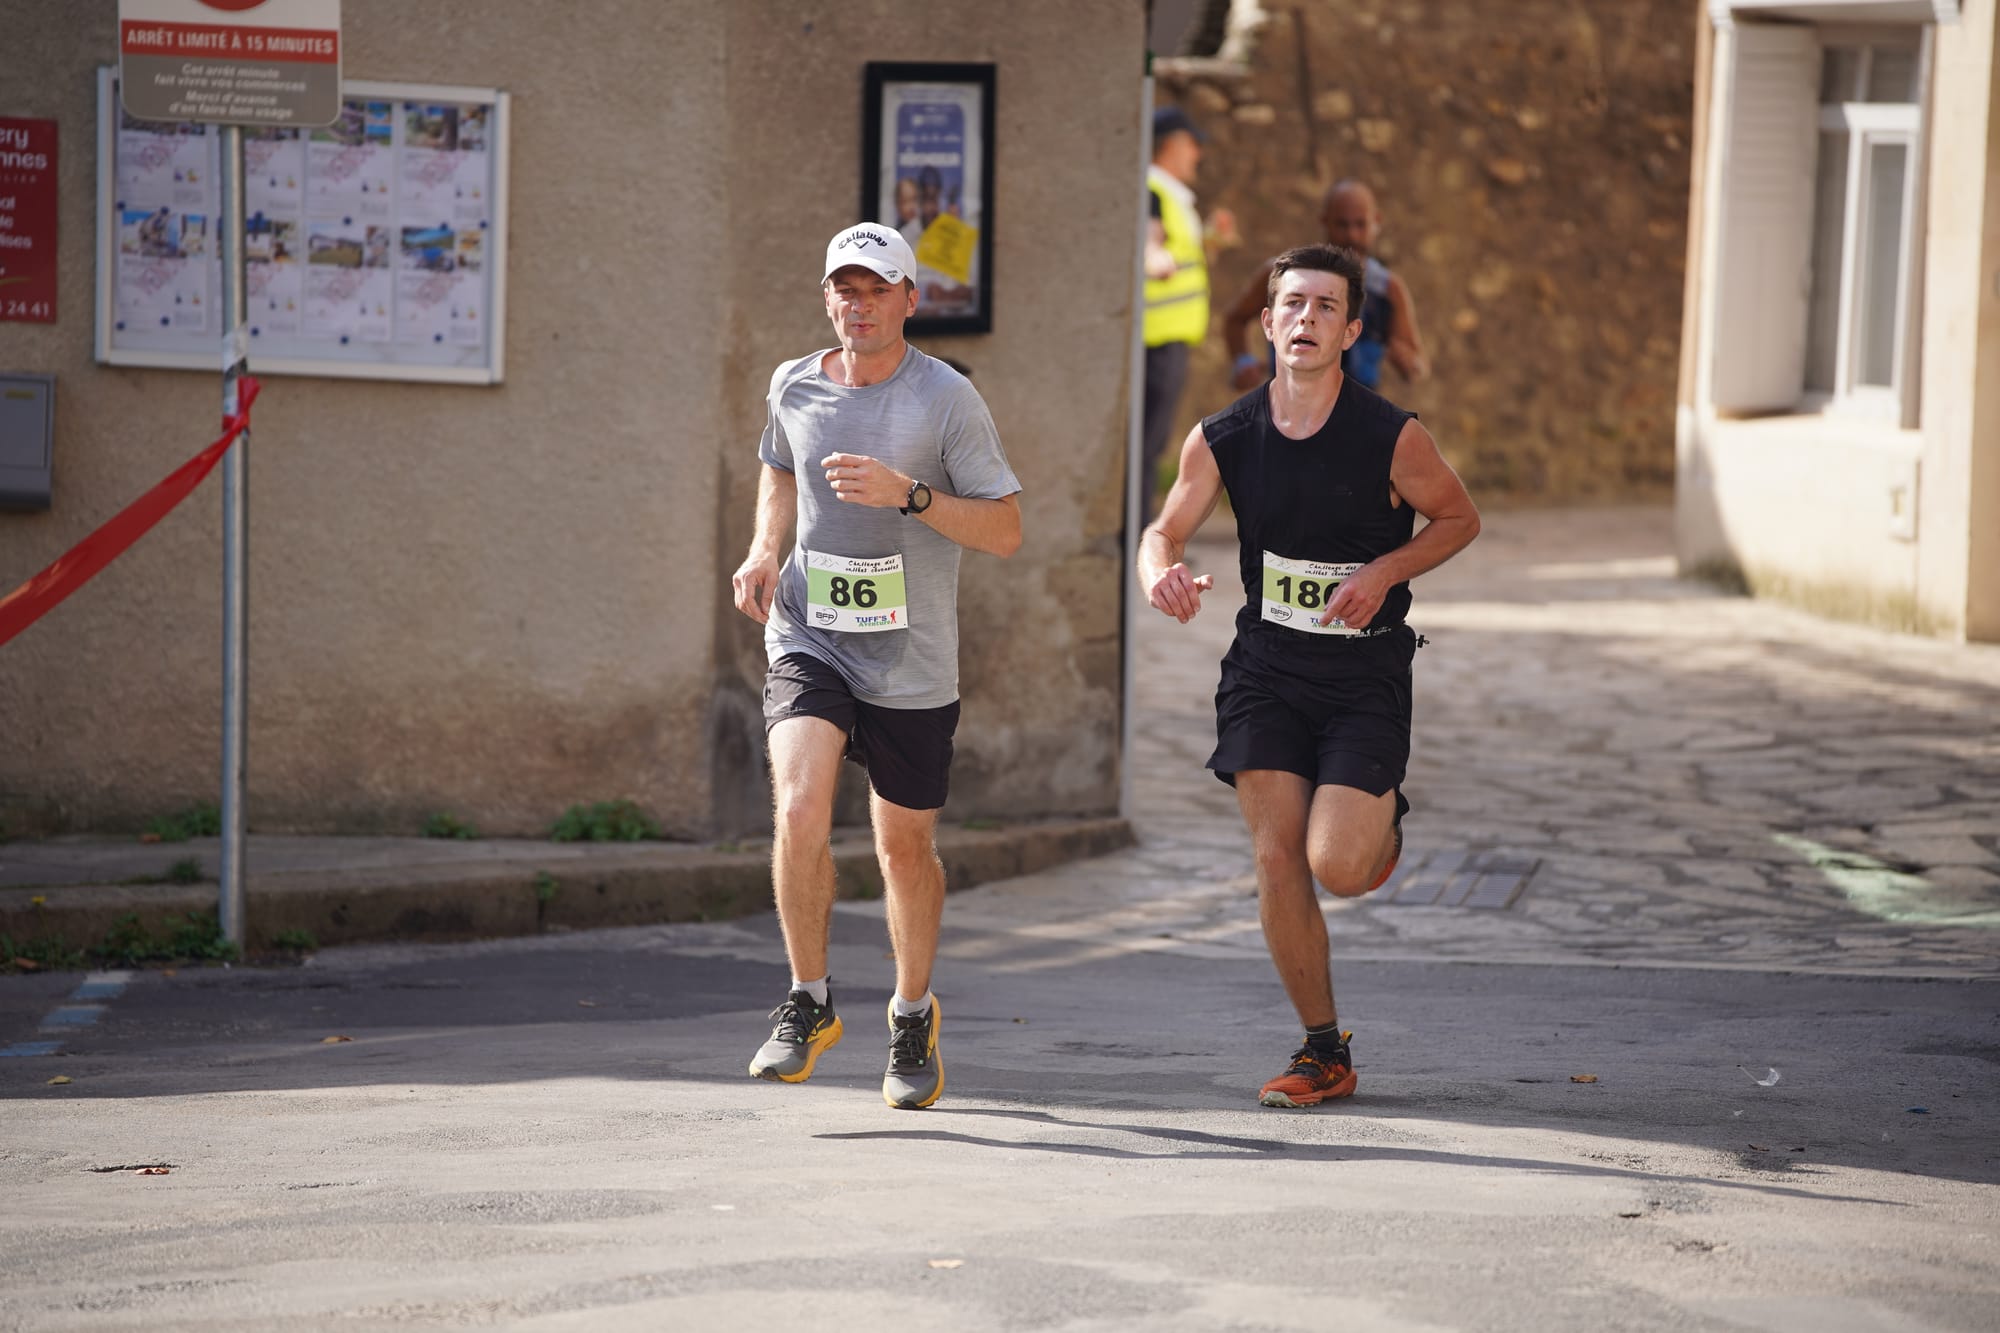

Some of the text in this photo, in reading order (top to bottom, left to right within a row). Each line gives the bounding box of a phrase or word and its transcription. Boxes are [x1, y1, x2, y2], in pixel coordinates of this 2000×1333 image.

[127, 28, 333, 55] ARRÊT LIMITÉ À 15 MINUTES
[182, 63, 280, 79] Cet arrêt minute
[154, 73, 306, 92] fait vivre vos commerces
[185, 90, 277, 105] Merci d'avance
[168, 102, 293, 120] d'en faire bon usage
[838, 231, 888, 249] Callaway
[7, 299, 26, 316] 24
[31, 301, 49, 317] 41
[848, 560, 880, 569] Challenge
[1308, 563, 1341, 572] Challenge
[830, 576, 878, 608] 86
[855, 615, 888, 623] TUFF'S
